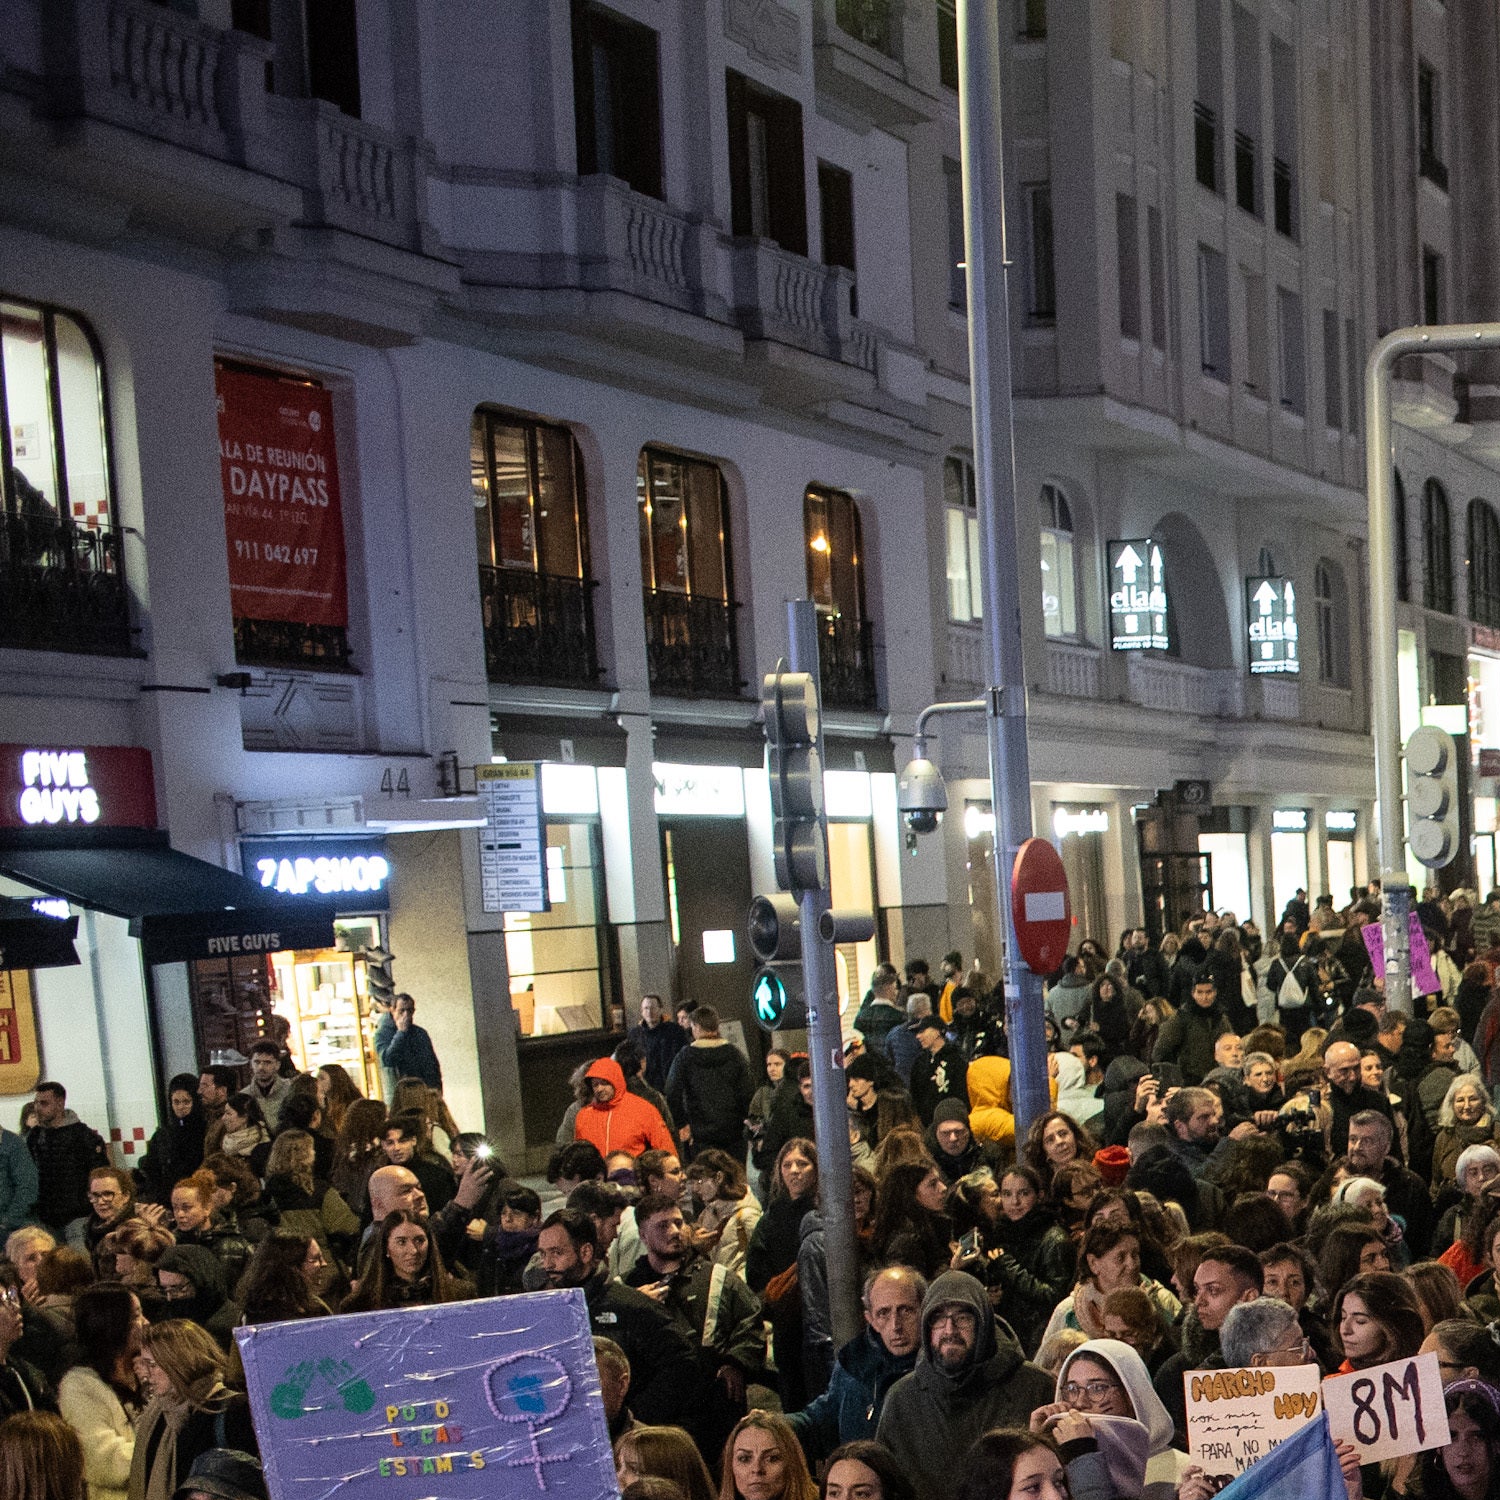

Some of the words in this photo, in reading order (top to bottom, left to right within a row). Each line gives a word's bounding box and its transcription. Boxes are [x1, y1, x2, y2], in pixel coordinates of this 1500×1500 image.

[220, 440, 242, 460] LA
[246, 444, 264, 464] DE
[266, 447, 326, 474] REUNIÓN
[229, 465, 329, 508] DAYPASS
[235, 539, 260, 560] 911
[264, 543, 291, 564] 042
[293, 548, 319, 566] 697
[20, 750, 89, 787] FIVE
[380, 767, 411, 795] 44
[19, 787, 100, 824] GUYS
[207, 934, 241, 954] FIVE
[242, 932, 281, 952] GUYS
[1191, 1368, 1276, 1403] MARCHO
[1273, 1391, 1318, 1420] HOY
[1351, 1361, 1426, 1445] 8M
[1242, 1438, 1260, 1454] NO
